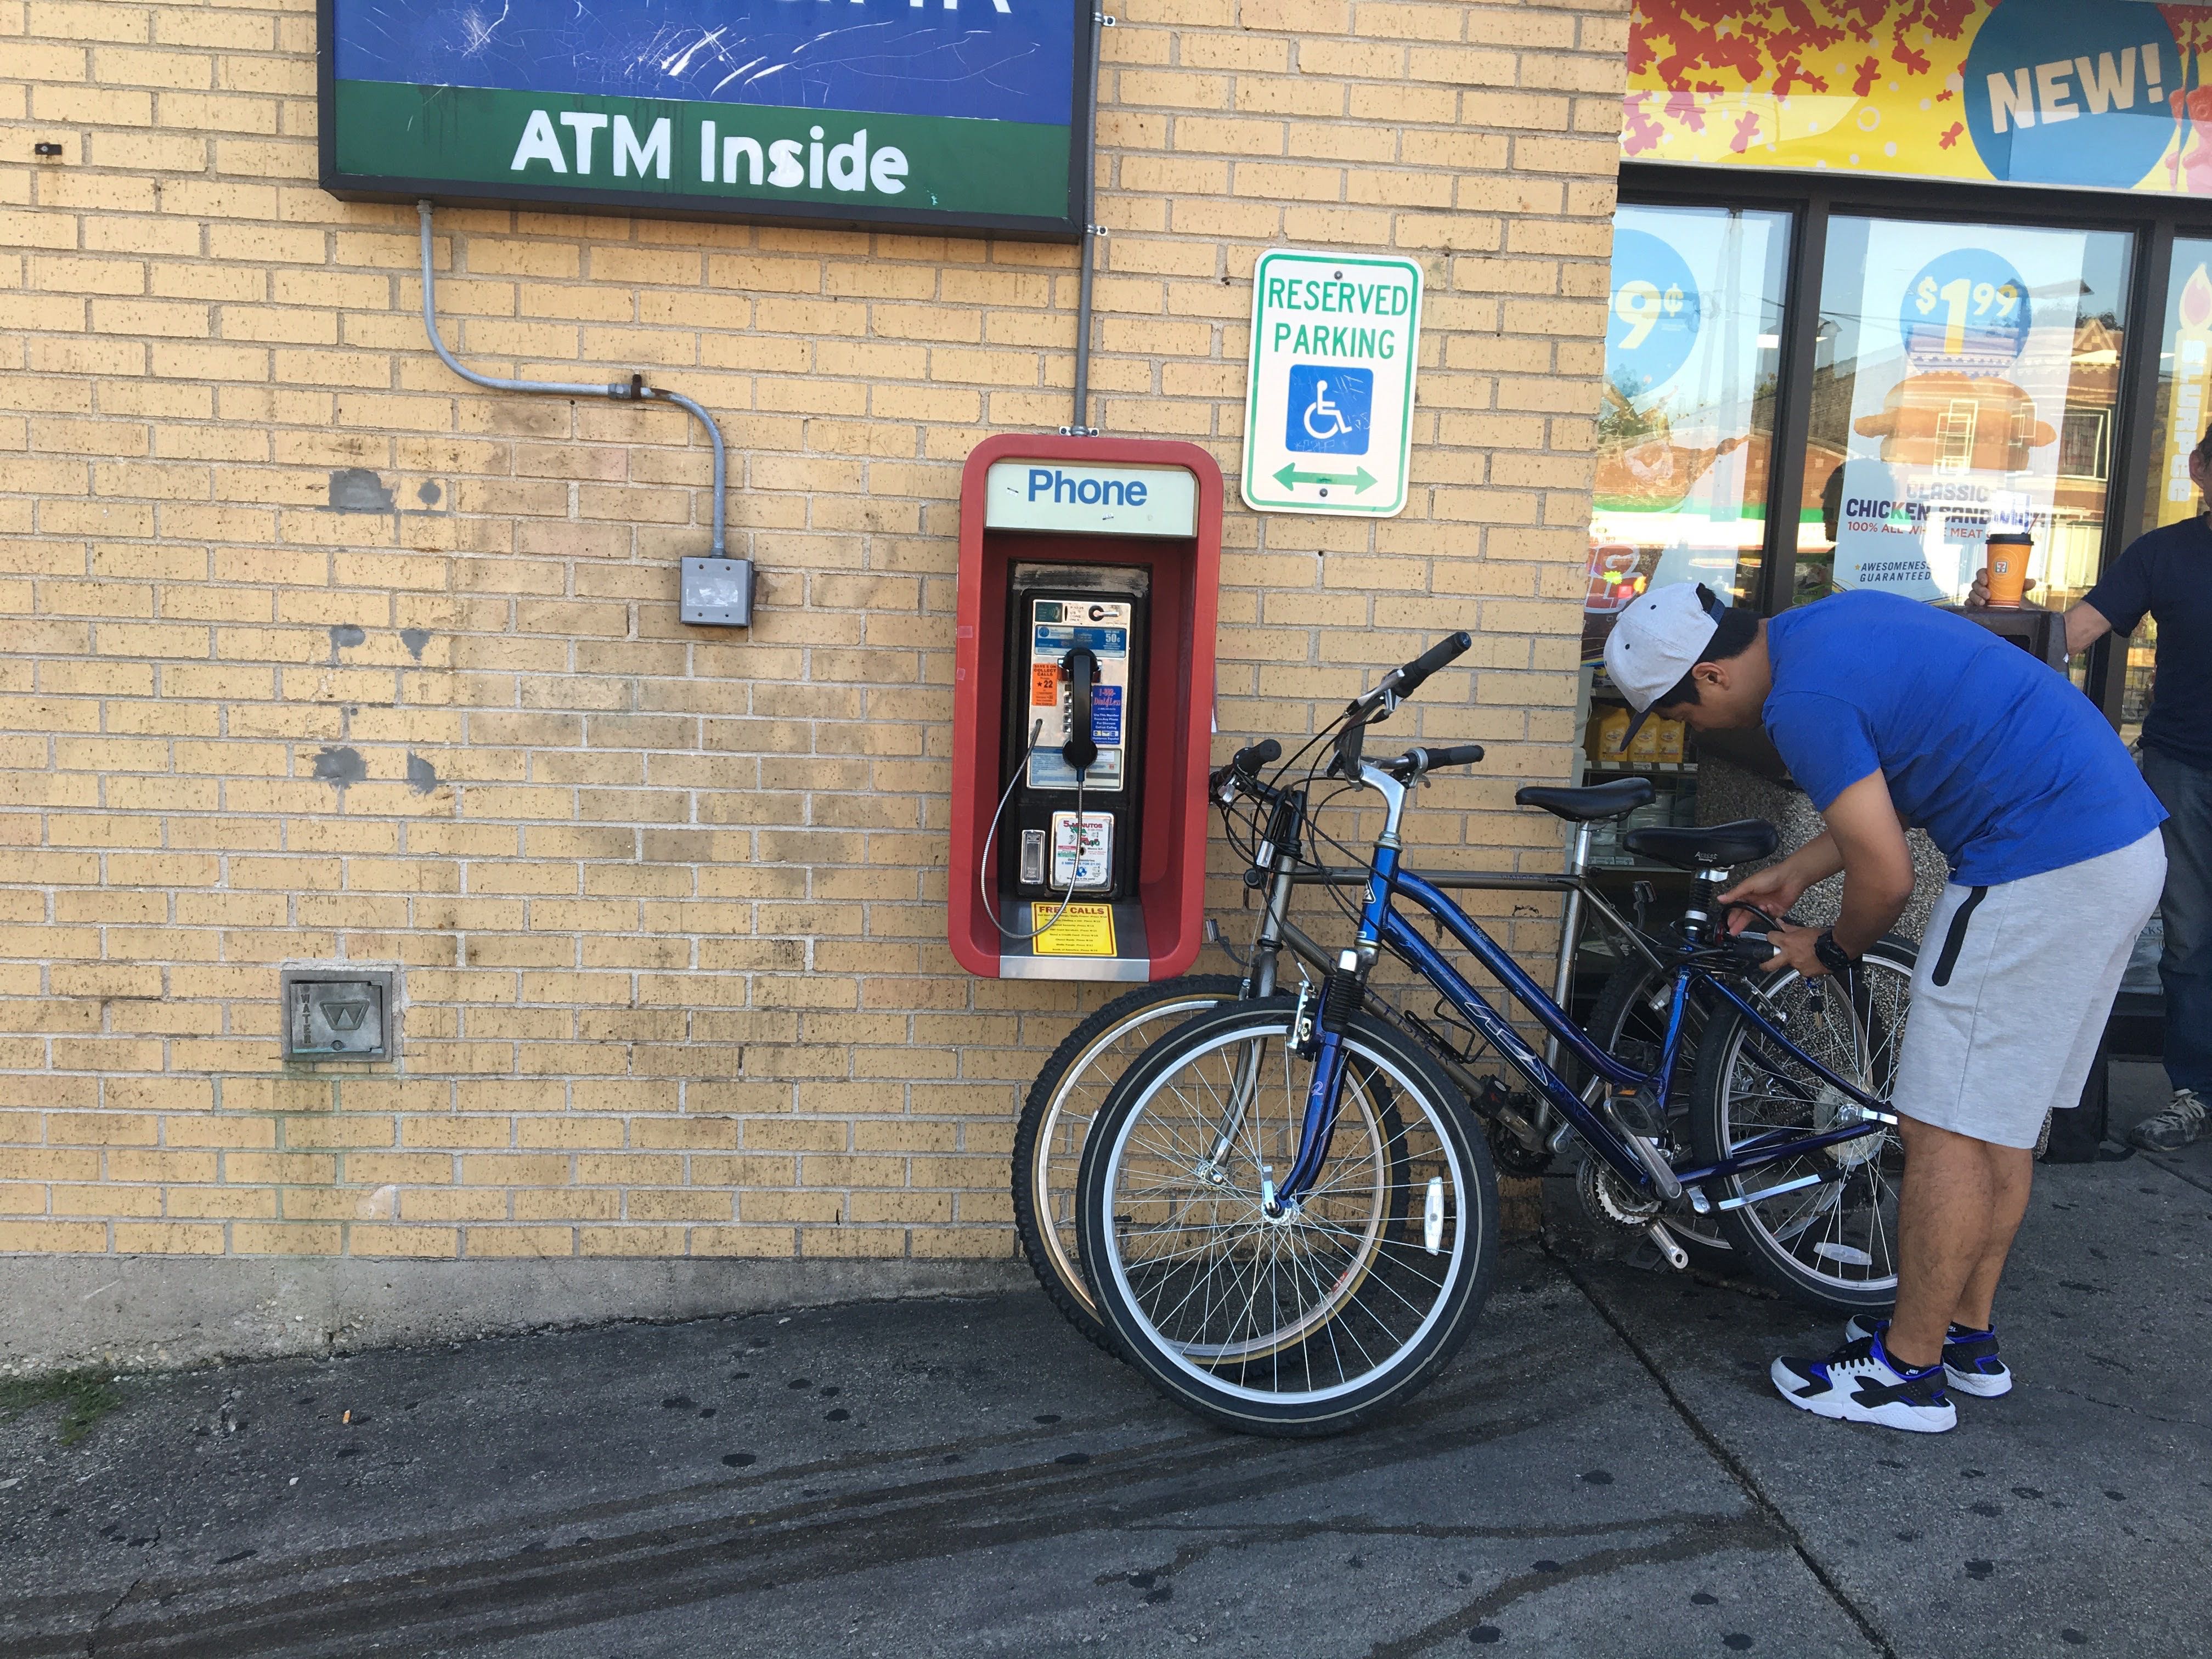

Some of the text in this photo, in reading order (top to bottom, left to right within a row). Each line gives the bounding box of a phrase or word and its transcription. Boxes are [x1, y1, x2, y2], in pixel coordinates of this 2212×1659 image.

[1987, 42, 2164, 134] NEW!
[510, 110, 910, 195] ATM Inside
[1268, 278, 1408, 316] RESERVED
[1608, 280, 1684, 349] 9¢
[1273, 323, 1395, 359] PARKING
[1028, 469, 1147, 506] Phone
[1906, 482, 1990, 503] CLASSIC
[1846, 498, 1931, 521] CHICKEN
[1848, 521, 1878, 533] 100%
[1950, 527, 1983, 538] MEAT
[1860, 571, 1931, 582] GUARANTEED
[1105, 633, 1121, 643] 50¢
[1043, 680, 1053, 688] 22
[300, 994, 312, 1043] WATER
